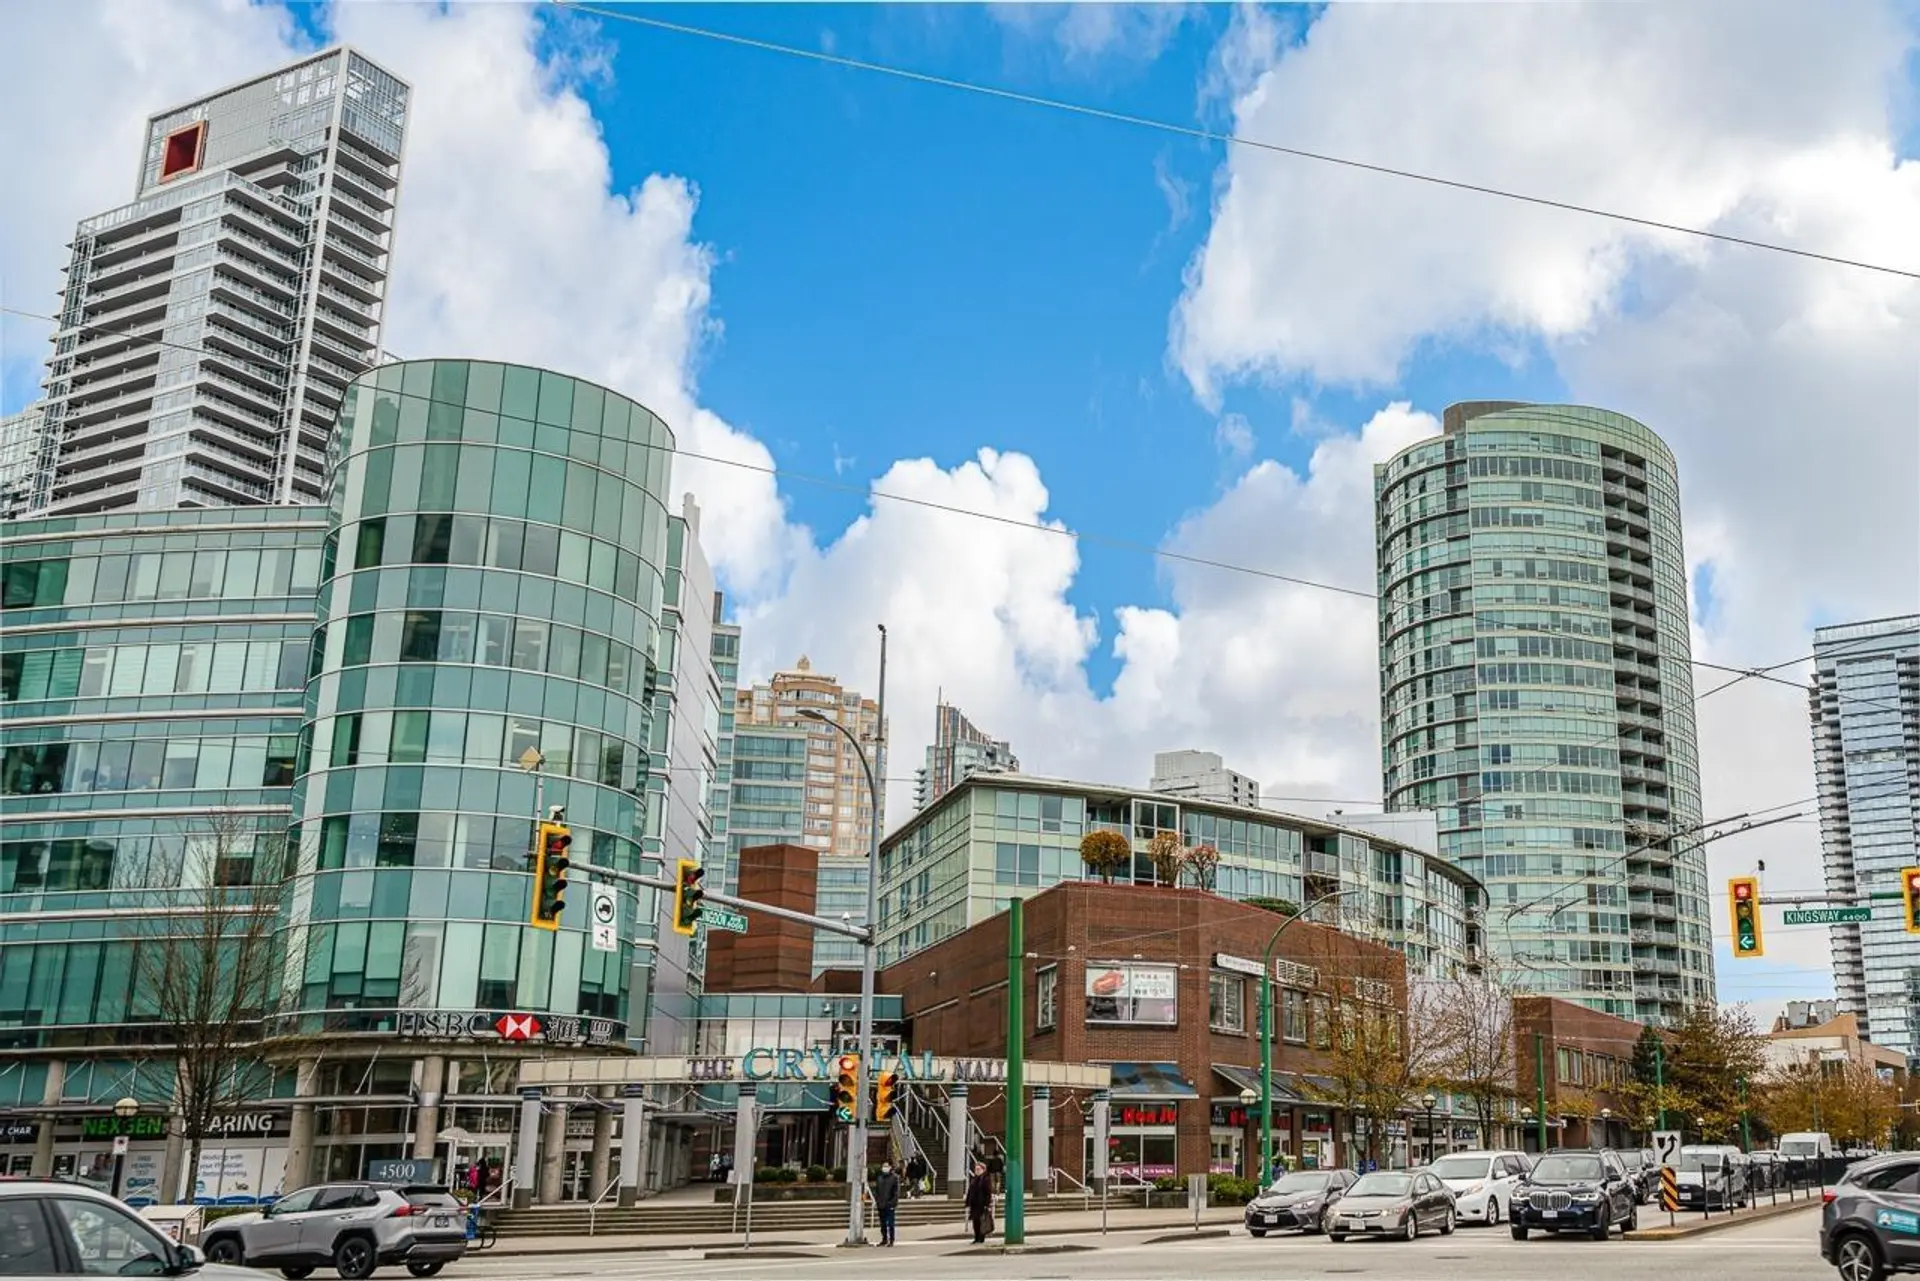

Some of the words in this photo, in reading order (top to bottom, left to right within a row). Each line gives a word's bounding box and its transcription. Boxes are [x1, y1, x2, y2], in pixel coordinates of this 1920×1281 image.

[1785, 910, 1840, 924] KINGSWAY
[1841, 913, 1867, 921] 4400
[396, 1012, 490, 1036] HSBC
[687, 1058, 734, 1081] THE
[742, 1047, 945, 1081] CRYTAL
[7, 1126, 31, 1136] CHAR
[379, 1163, 415, 1179] 4500
